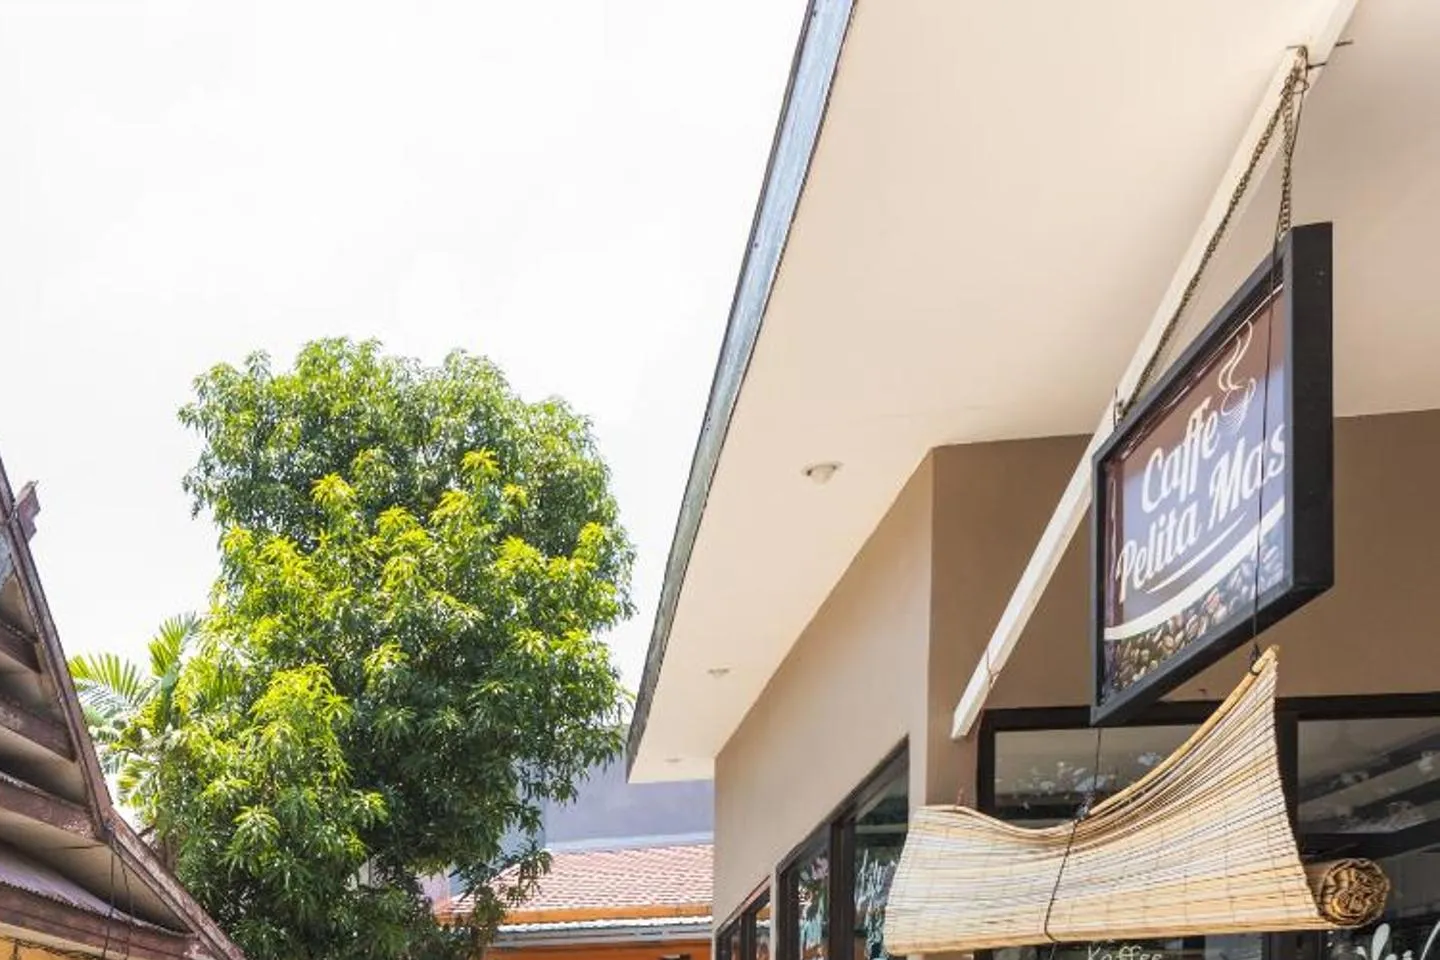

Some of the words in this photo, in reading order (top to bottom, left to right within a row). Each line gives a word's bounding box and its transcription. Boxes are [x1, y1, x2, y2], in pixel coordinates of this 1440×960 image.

[1115, 500, 1202, 604] Pelita
[1207, 424, 1285, 532] Mas
[1141, 397, 1219, 514] Caffe
